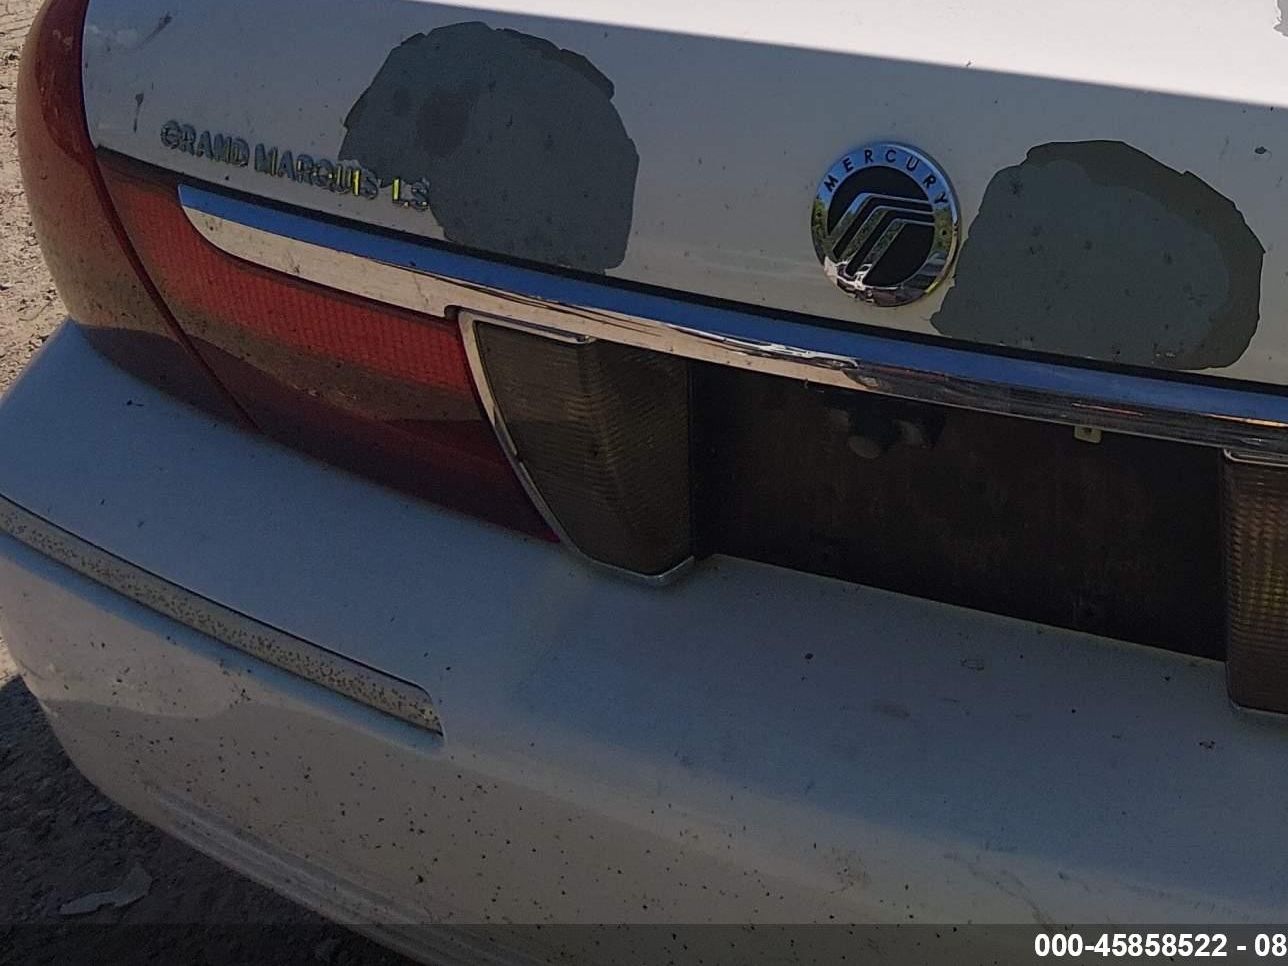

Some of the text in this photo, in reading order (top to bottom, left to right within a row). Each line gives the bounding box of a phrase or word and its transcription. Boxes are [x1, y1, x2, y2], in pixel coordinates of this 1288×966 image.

[160, 120, 430, 211] GRAND MARQUIS LS
[823, 148, 949, 205] MERCURY
